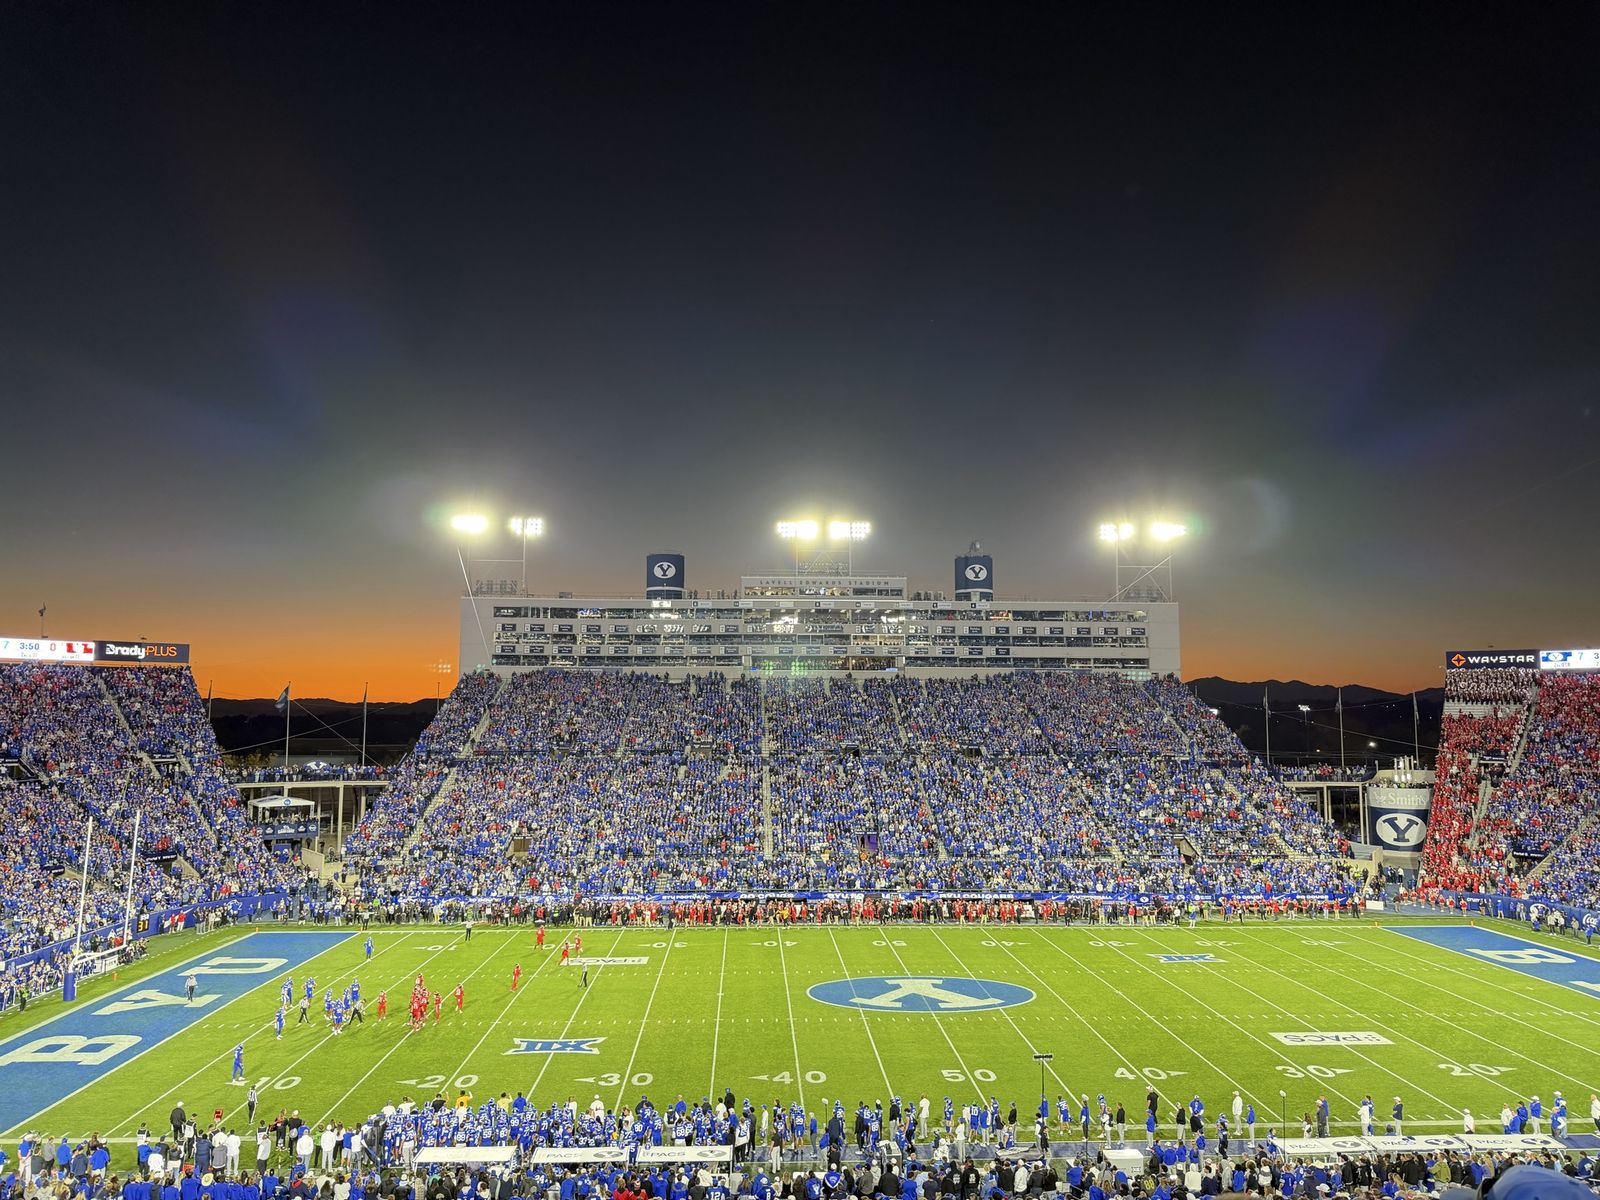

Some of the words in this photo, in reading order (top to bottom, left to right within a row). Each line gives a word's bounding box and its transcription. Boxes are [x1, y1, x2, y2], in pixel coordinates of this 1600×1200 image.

[657, 563, 672, 577] Y
[968, 566, 984, 579] Y
[20, 642, 40, 650] 3:50
[50, 642, 57, 652] 0
[1468, 654, 1535, 664] WAYSTAR
[1382, 816, 1420, 842] Y
[137, 920, 149, 932] 31
[849, 978, 1004, 1009] Y
[1283, 1033, 1362, 1043] PACS
[940, 1068, 998, 1083] 50
[1114, 1066, 1169, 1082] 40
[1275, 1064, 1336, 1079] 30
[1438, 1062, 1502, 1077] 20
[251, 1076, 302, 1090] 10
[417, 1074, 479, 1089] 20
[597, 1071, 654, 1086] 30
[772, 1069, 828, 1085] 40
[1143, 1179, 1155, 1191] 88
[710, 1190, 721, 1200] 12
